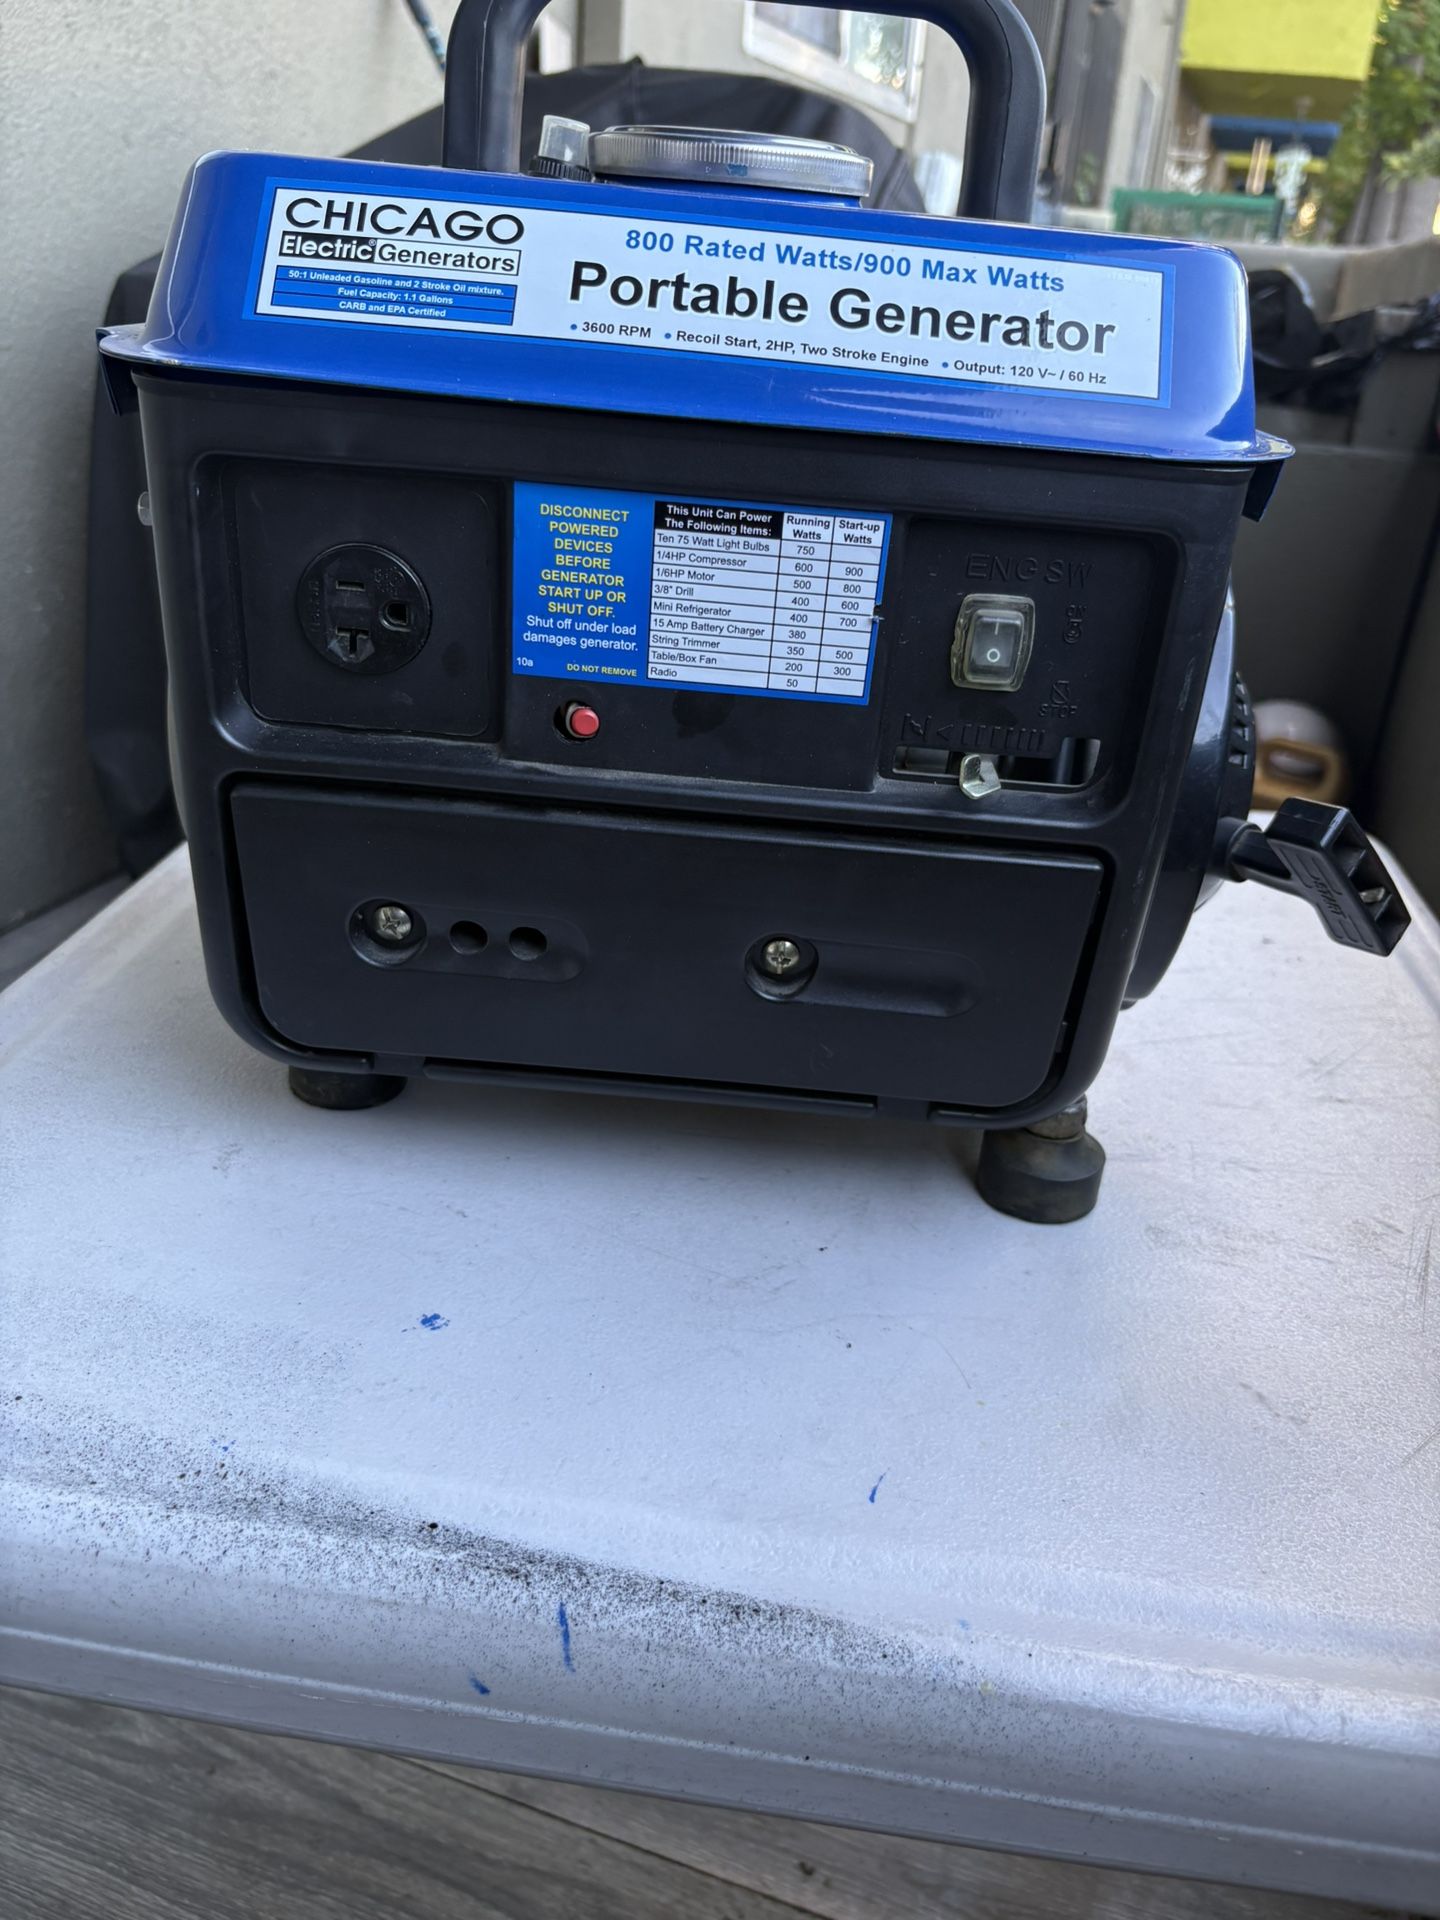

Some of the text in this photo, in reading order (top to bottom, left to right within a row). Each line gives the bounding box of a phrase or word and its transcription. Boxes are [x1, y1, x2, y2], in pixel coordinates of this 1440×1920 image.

[285, 198, 524, 245] CHICAGO
[378, 243, 516, 272] Generators
[625, 230, 1064, 292] 800 Rated Watts/900 Max Watts
[289, 270, 504, 295] 50:1 Unleaded Gasoline and 2 Stroke Oil mixture.
[338, 287, 453, 304] Fuel Capacity: 1.1 Gallons
[339, 301, 446, 317] CARB and EPA Certified
[570, 260, 1116, 354] Portable Generator
[582, 322, 651, 338] 3600 RPM
[676, 330, 929, 369] Recoil Start, 2HP, Two Stroke Engine
[954, 360, 1005, 376] Output:
[1010, 365, 1033, 377] 120
[1068, 371, 1084, 382] 60
[1088, 372, 1107, 384] Hz
[540, 504, 629, 522] DISCONNECT
[667, 505, 772, 523] This Unit Can Power
[787, 515, 830, 529] Running
[550, 522, 618, 538] POWERED
[665, 518, 771, 536] The Following Items:
[793, 530, 821, 540] Watts
[839, 520, 880, 533] Start-up
[554, 538, 612, 553] DEVICES
[657, 533, 814, 555] Ten 75 Watt Light Bulbs 750
[844, 533, 872, 544] Watts
[556, 555, 611, 569] BEFORE
[657, 551, 863, 576] 1/4HP Compressor 600 900
[966, 553, 1039, 581] ENG
[541, 569, 624, 586] GENERATOR
[656, 568, 861, 593] 1/6HP Motor 500 800
[538, 586, 626, 603] START UP OR
[676, 586, 694, 596] Drill
[792, 597, 809, 606] 400
[841, 601, 859, 610] 600
[548, 602, 615, 618] SHUT OFF.
[654, 602, 857, 627] Mini Refrigerator 400 700
[527, 615, 636, 635] Shut off under load
[654, 618, 806, 639] 15 Amp Battery Charger 380
[523, 631, 638, 651] damages generator.
[652, 635, 853, 660] String Trimmer 350 500
[517, 657, 533, 667] 10a
[582, 665, 599, 673] NOT
[601, 667, 637, 676] REMOVE
[651, 651, 851, 675] Table/Box Fan 200 300
[650, 667, 798, 687] Radio 50
